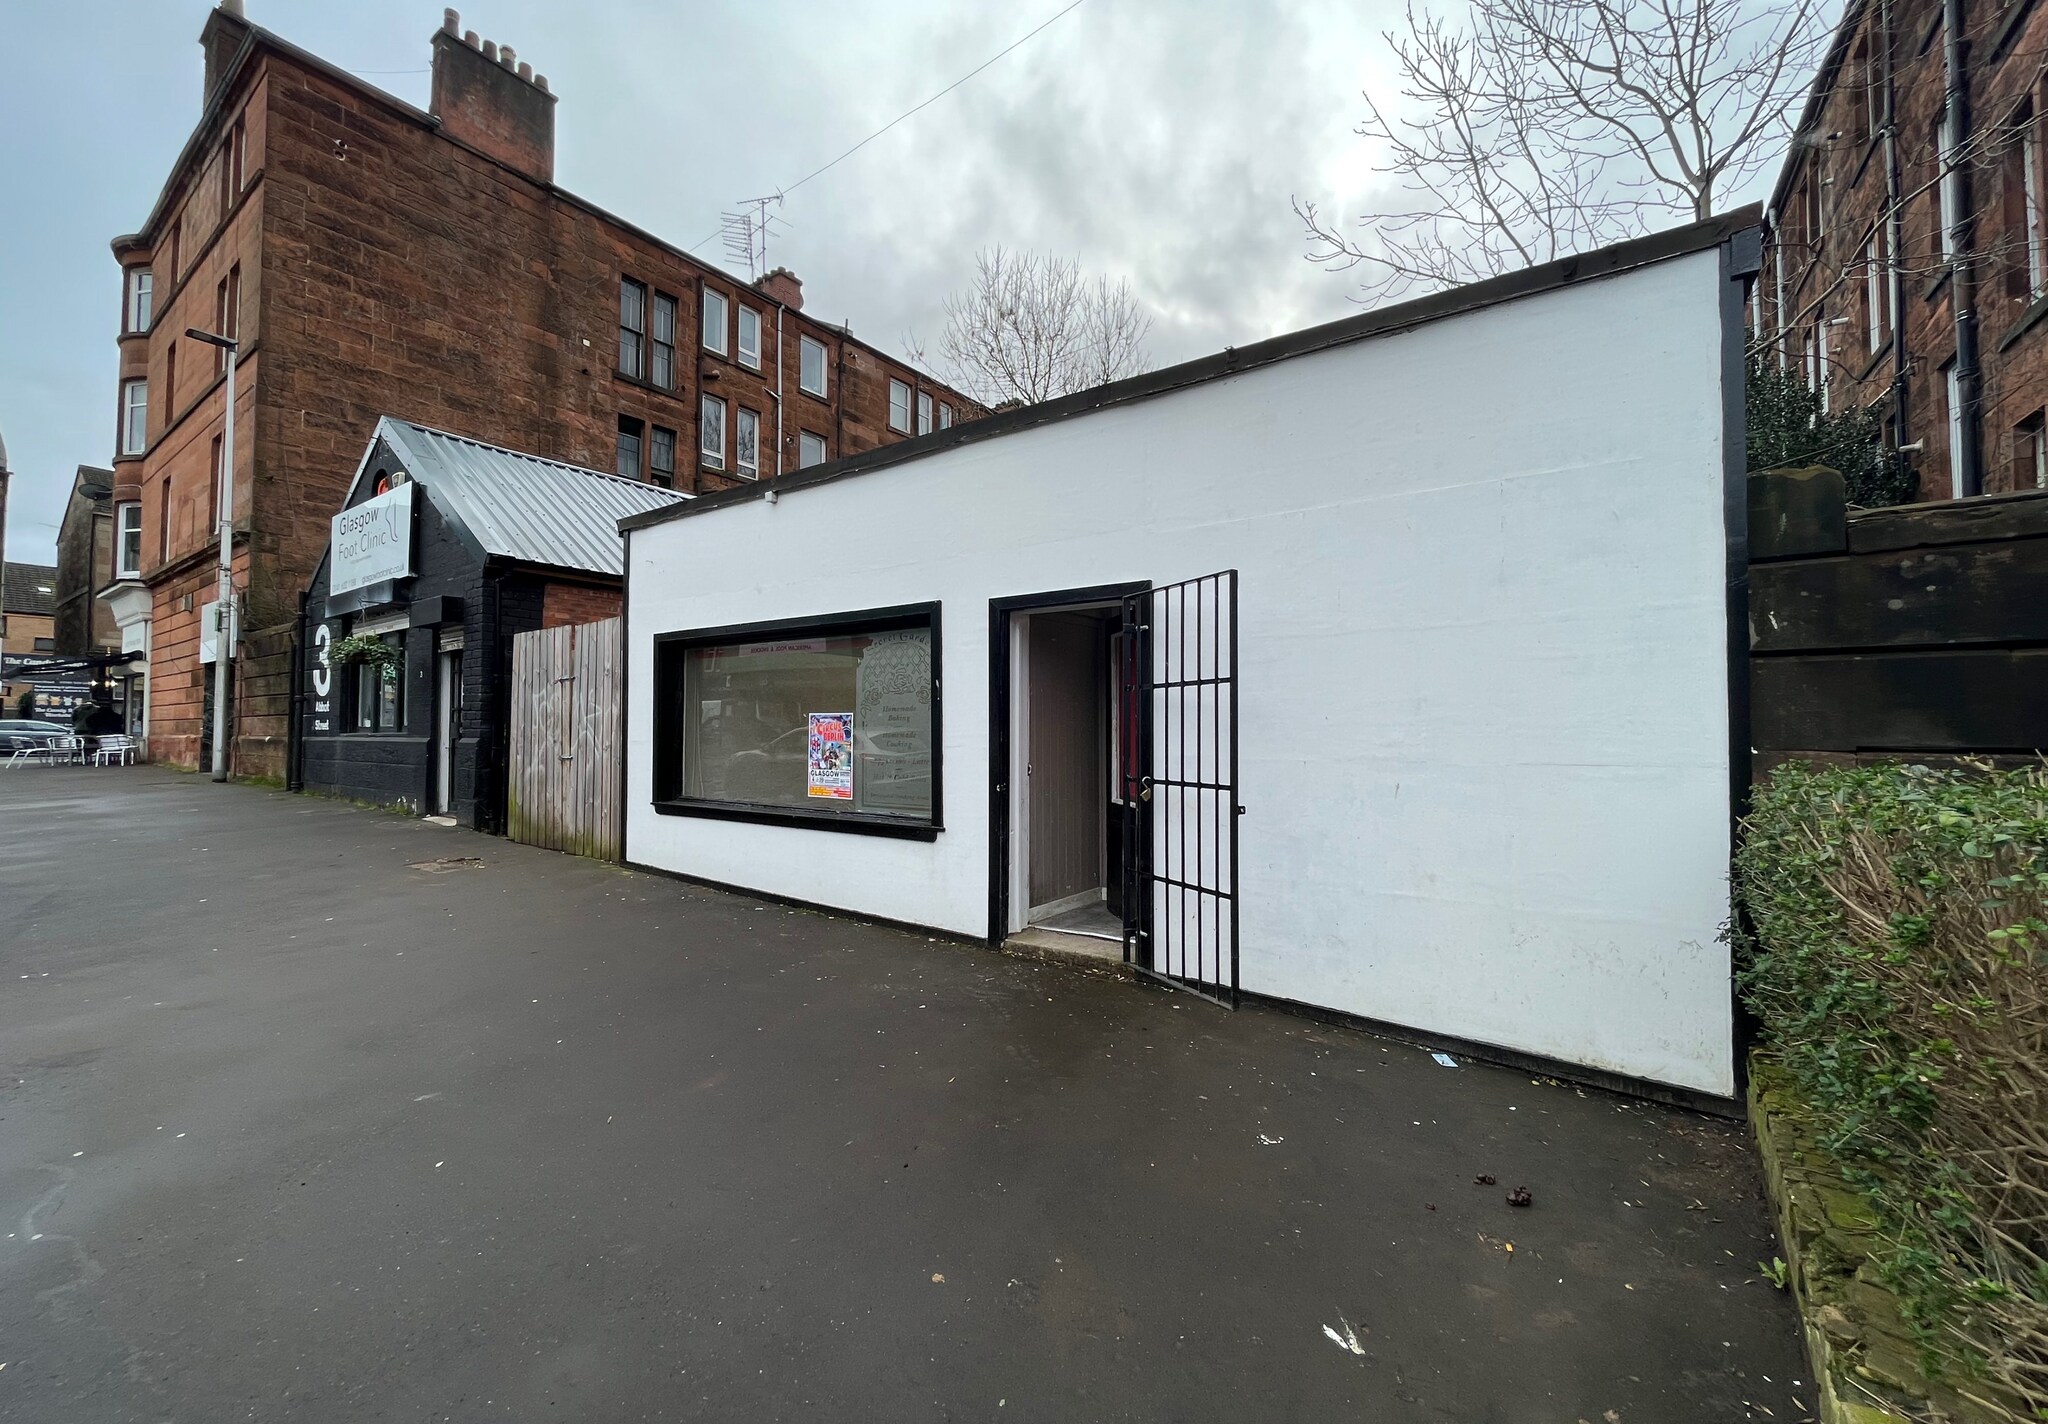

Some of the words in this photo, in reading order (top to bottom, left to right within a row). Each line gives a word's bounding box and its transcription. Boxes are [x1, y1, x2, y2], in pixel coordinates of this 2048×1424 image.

[340, 508, 380, 535] Glasgow
[338, 540, 358, 561] Foot
[360, 529, 386, 552] Clinic
[313, 624, 331, 697] 3
[817, 721, 841, 735] CIRCUS
[824, 732, 844, 741] BERLIN
